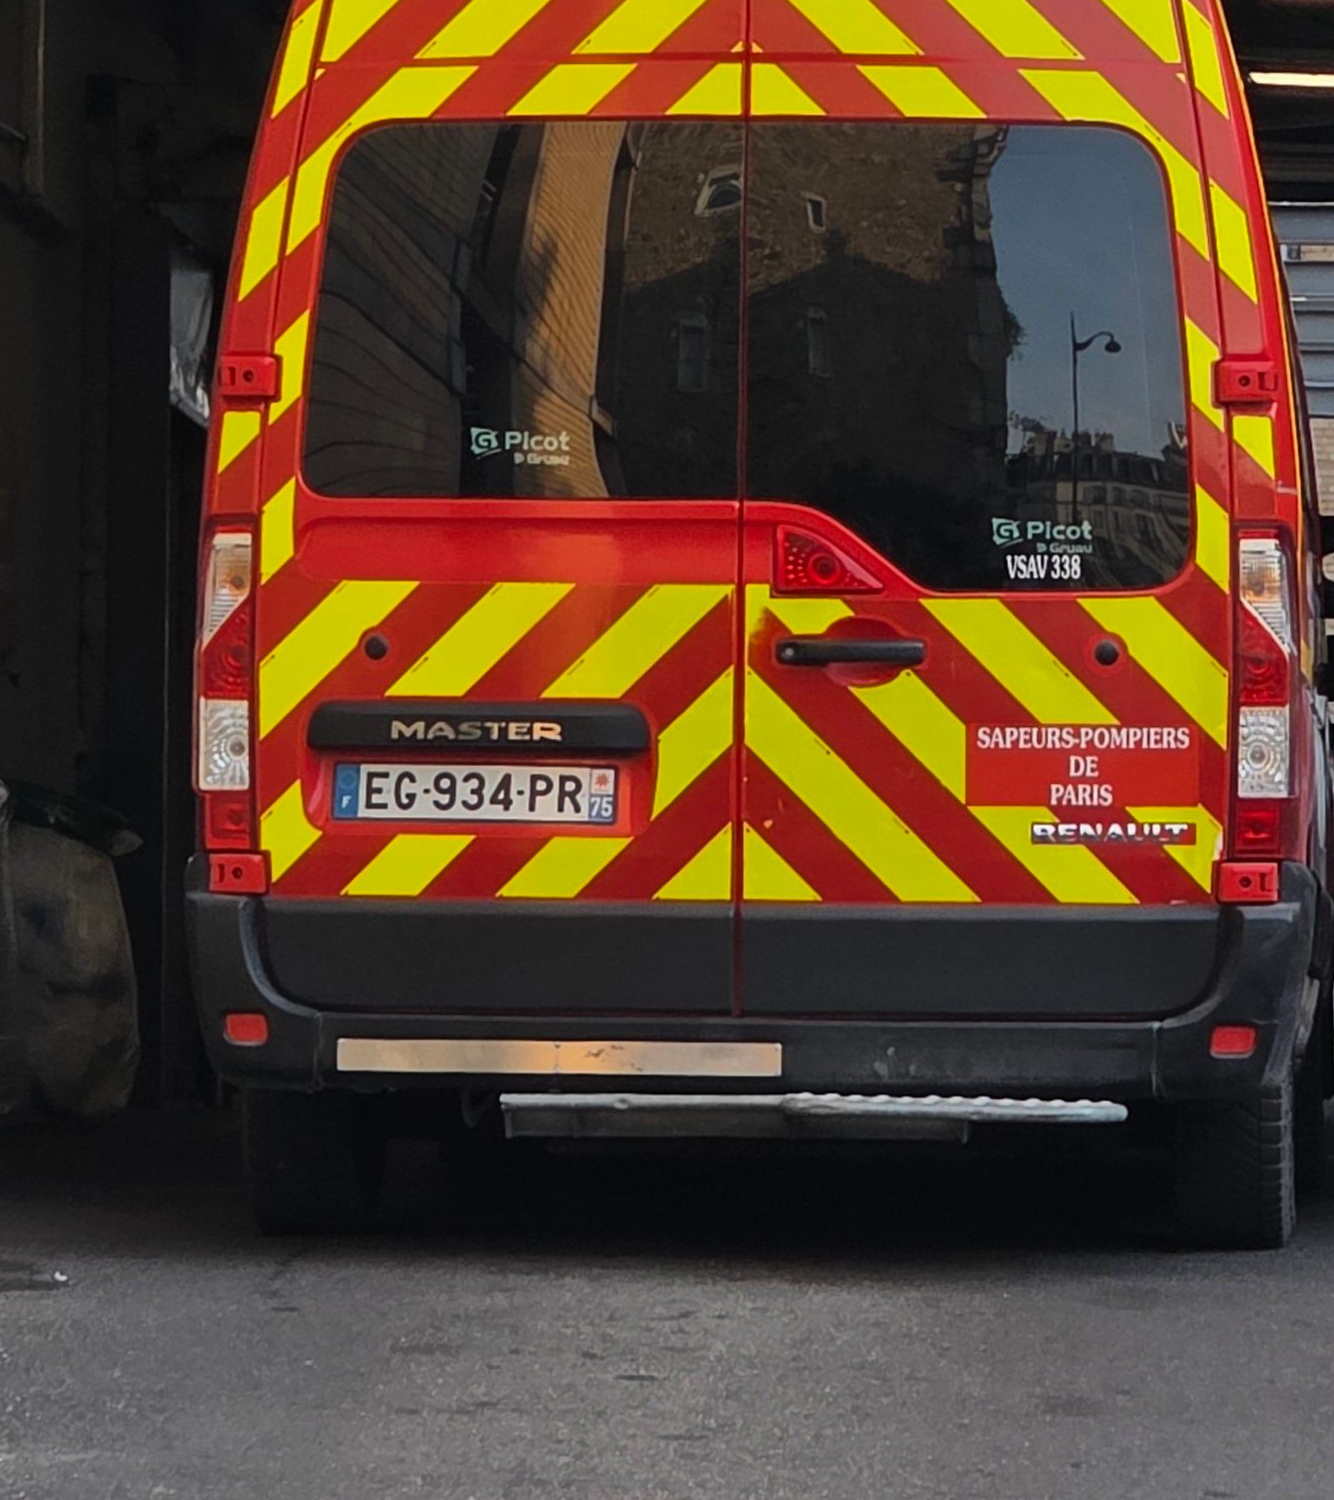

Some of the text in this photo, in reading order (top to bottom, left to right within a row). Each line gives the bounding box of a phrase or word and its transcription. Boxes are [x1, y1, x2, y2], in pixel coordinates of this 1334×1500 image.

[505, 430, 570, 451] Picot
[1026, 520, 1093, 540] Picot
[1005, 554, 1081, 580] VSAV 338
[390, 720, 563, 741] MASTER
[976, 726, 1191, 750] SAPEURS-POMPIERS
[1068, 755, 1100, 778] DE
[364, 770, 584, 814] EG-934-PR
[589, 797, 614, 818] 75
[1049, 783, 1114, 807] PARIS
[1032, 822, 1189, 843] RENAULT
